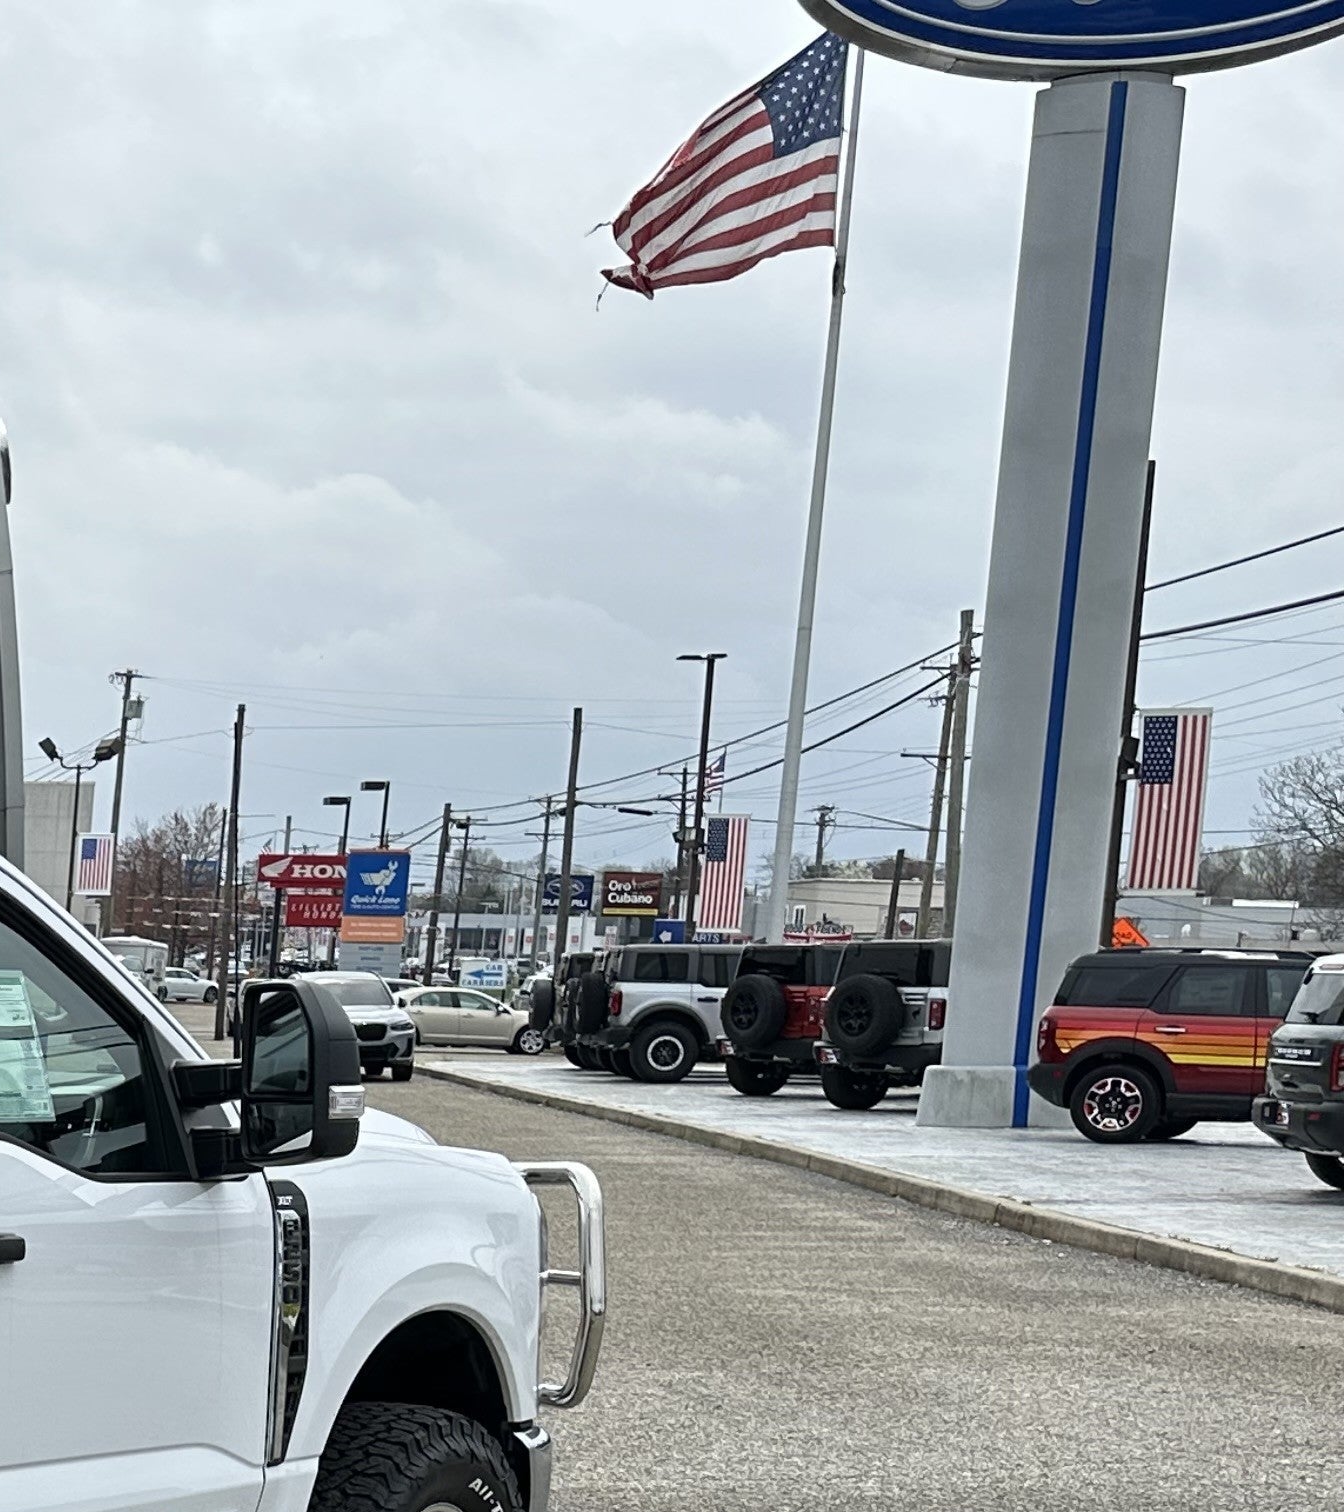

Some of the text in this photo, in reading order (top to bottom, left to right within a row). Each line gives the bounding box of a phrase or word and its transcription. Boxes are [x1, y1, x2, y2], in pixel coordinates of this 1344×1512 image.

[291, 864, 347, 879] HON
[609, 880, 631, 891] Oro
[542, 899, 588, 907] SURU
[608, 892, 652, 904] Cubano
[291, 903, 341, 912] LILLIST
[693, 933, 720, 943] ARTS
